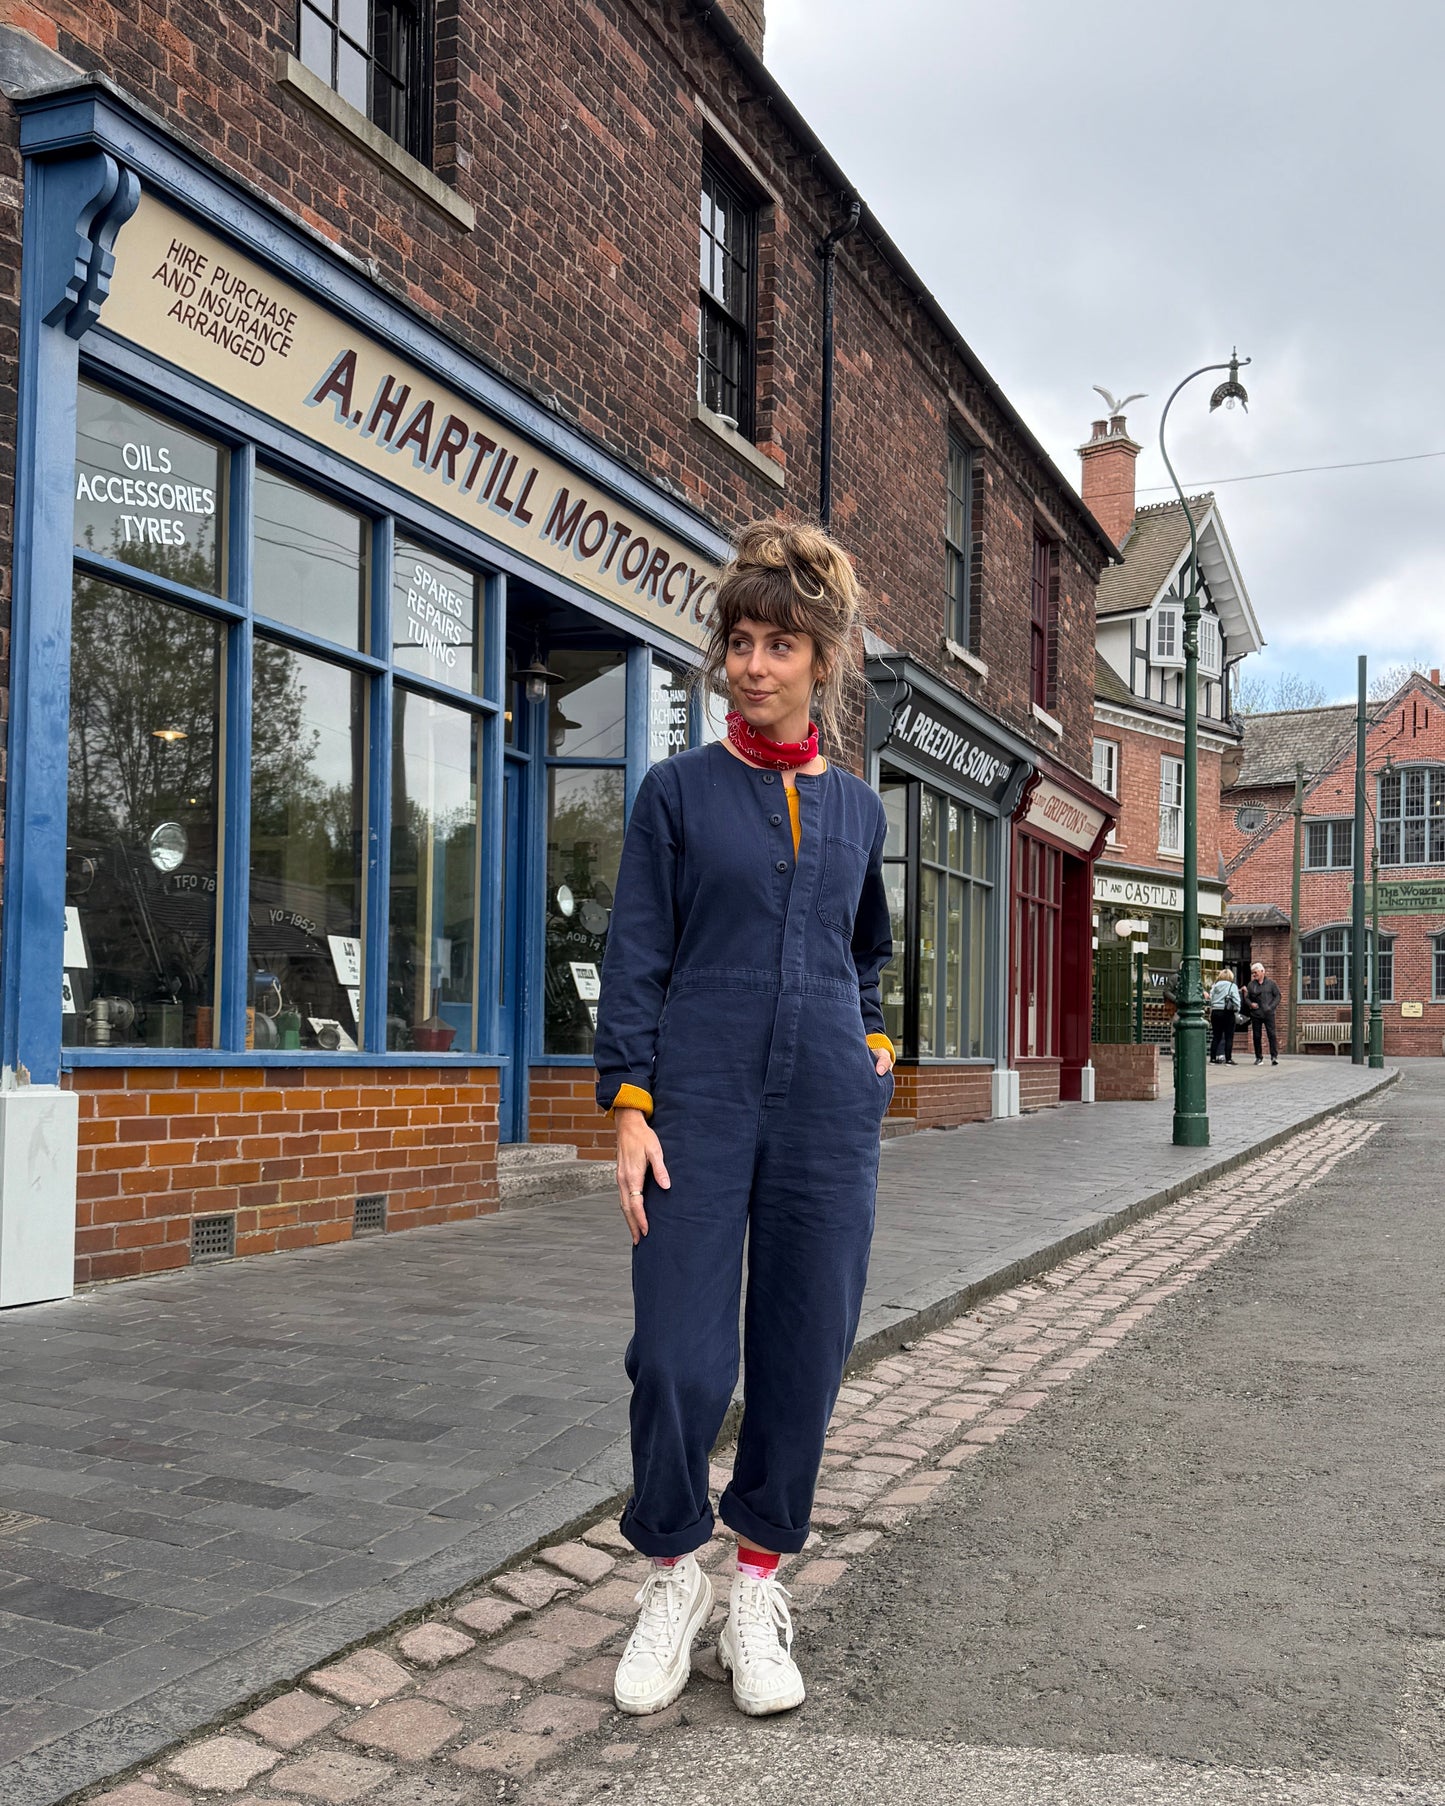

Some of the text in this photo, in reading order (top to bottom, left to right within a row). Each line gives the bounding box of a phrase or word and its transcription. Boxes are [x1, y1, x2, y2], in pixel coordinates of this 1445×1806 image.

[152, 262, 293, 358] AND INSURANCE
[166, 238, 298, 333] HIRE PURCHASE
[167, 299, 265, 367] ARRANGED
[122, 442, 172, 474] OILS
[76, 472, 216, 515] ACCESSORIES
[120, 514, 186, 546] TYRES
[407, 587, 462, 645] REPAIRS
[413, 564, 463, 618] SPARES
[407, 615, 456, 668] TUNING
[658, 729, 686, 746] STOCK
[1125, 882, 1177, 907] CASTLE
